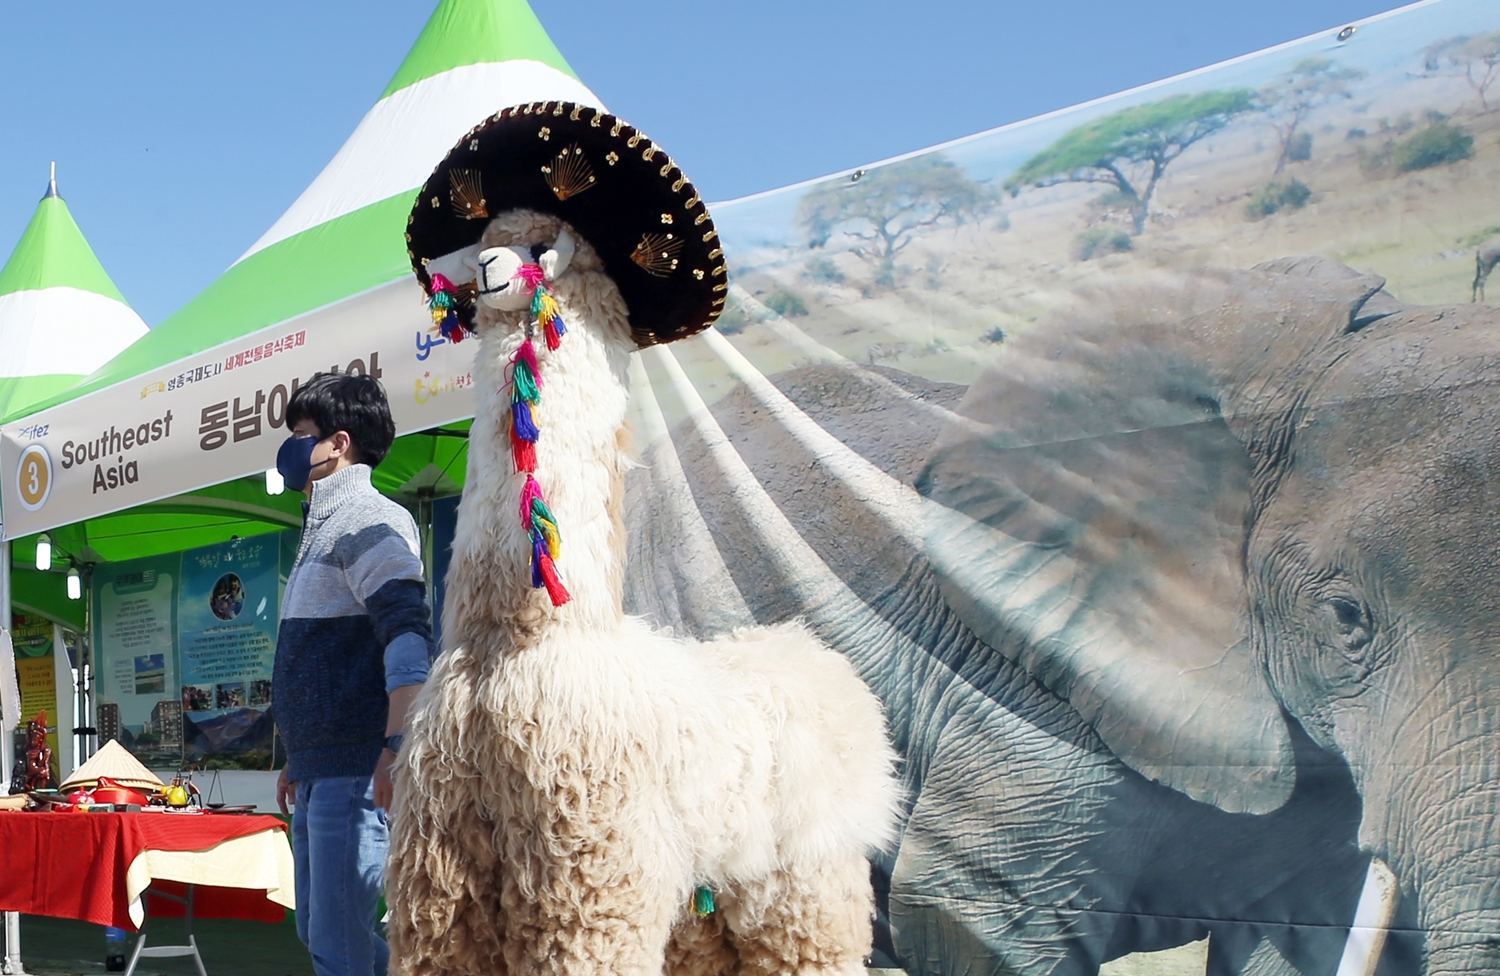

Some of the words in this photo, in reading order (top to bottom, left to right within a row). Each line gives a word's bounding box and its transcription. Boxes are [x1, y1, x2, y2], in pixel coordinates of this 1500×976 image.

[167, 363, 222, 392] 영종국제도시
[224, 330, 306, 371] 세계전통음식축제
[61, 410, 173, 469] Southeast
[27, 461, 40, 495] 3
[92, 456, 139, 494] Asia
